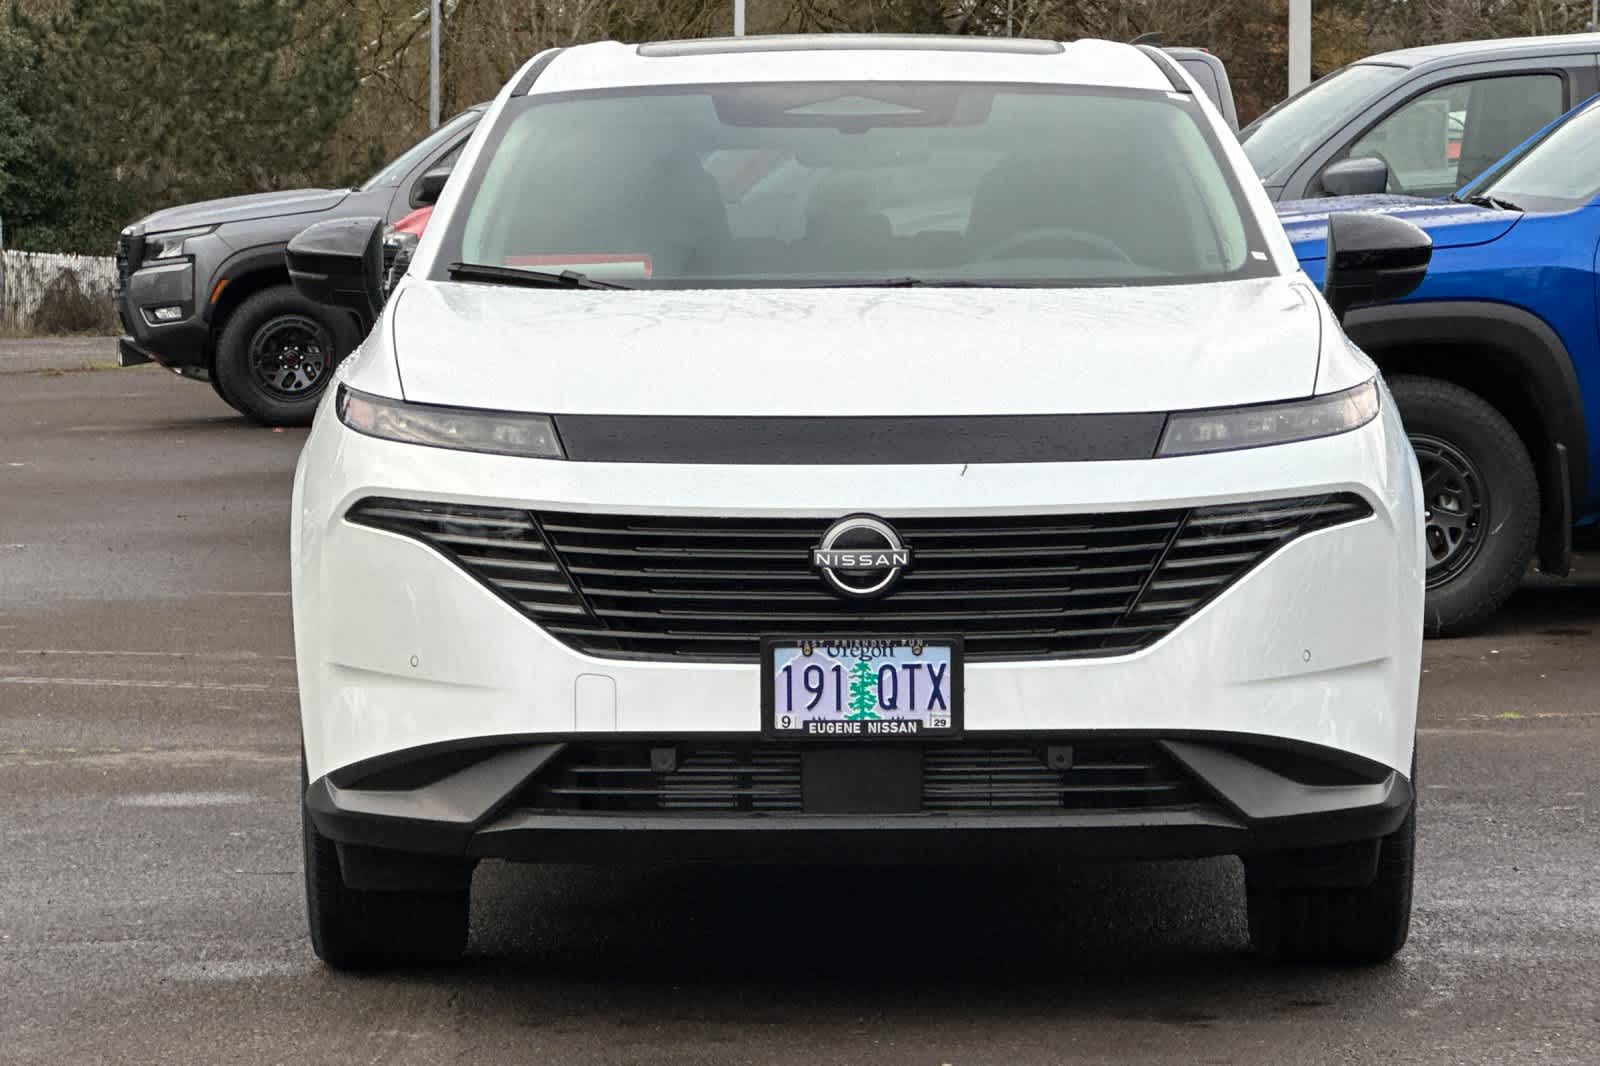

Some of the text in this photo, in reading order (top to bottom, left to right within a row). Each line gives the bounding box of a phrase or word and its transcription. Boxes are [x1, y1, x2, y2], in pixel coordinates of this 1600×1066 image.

[816, 553, 907, 567] NISSAN
[827, 644, 897, 661] Oregon
[782, 663, 947, 712] 191 QTX
[782, 715, 791, 729] 9
[809, 721, 917, 734] EUGENE NISSAN
[934, 719, 947, 727] 29
